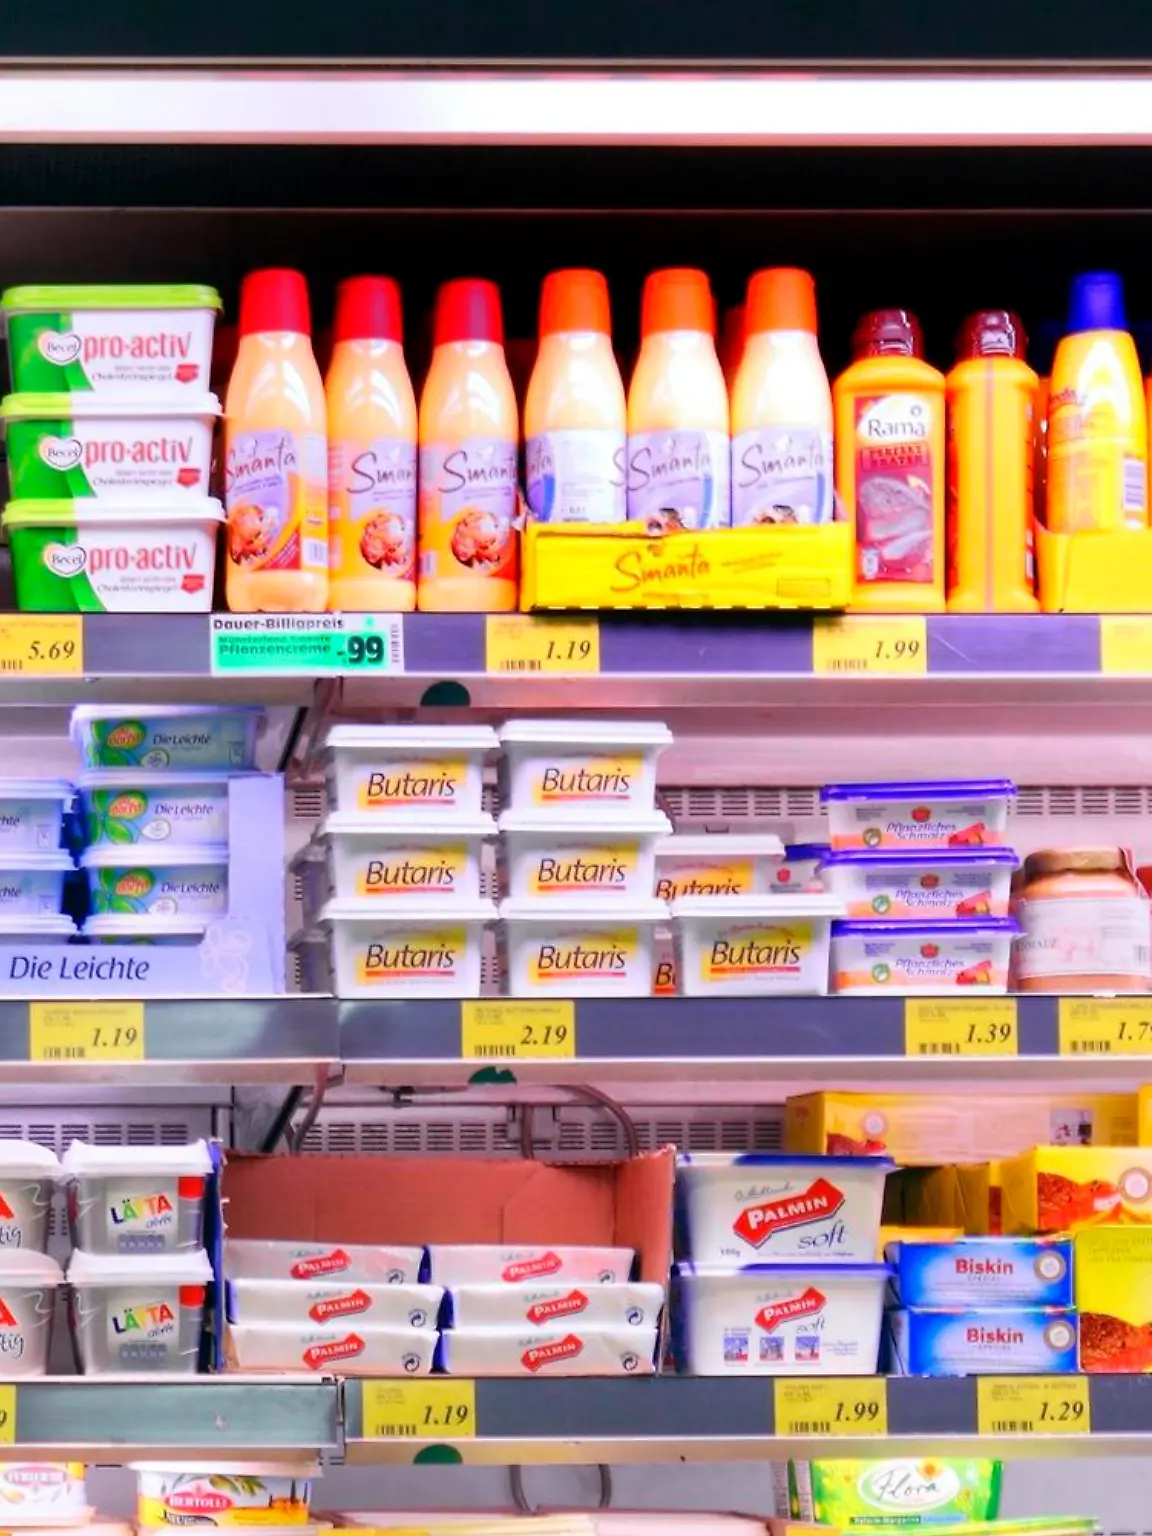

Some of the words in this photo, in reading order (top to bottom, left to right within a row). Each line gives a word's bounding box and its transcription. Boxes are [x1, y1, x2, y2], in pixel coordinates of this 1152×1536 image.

[214, 618, 344, 631] Dauer-Billigpreis
[28, 641, 75, 661] 5.69
[545, 641, 591, 661] 1.19
[874, 641, 921, 660] 1.99
[366, 771, 455, 798] Butaris
[542, 767, 631, 794] Butaris
[366, 860, 454, 886] Butaris
[538, 858, 626, 884] Butaris
[365, 943, 454, 970] Butaris
[538, 945, 626, 971] Butaris
[711, 940, 801, 966] Butaris
[9, 955, 53, 980] Die
[60, 955, 150, 981] Leichte
[91, 1027, 137, 1048] 1.19
[520, 1025, 567, 1046] 2.19
[966, 1023, 1012, 1044] 1.39
[748, 1193, 829, 1230] PALMIN
[798, 1223, 850, 1250] soft
[955, 1258, 1014, 1275] Biskin
[966, 1327, 1024, 1344] Biskin
[422, 1404, 468, 1425] 1.19
[834, 1401, 879, 1421] 1.99
[1038, 1401, 1084, 1421] 1.29
